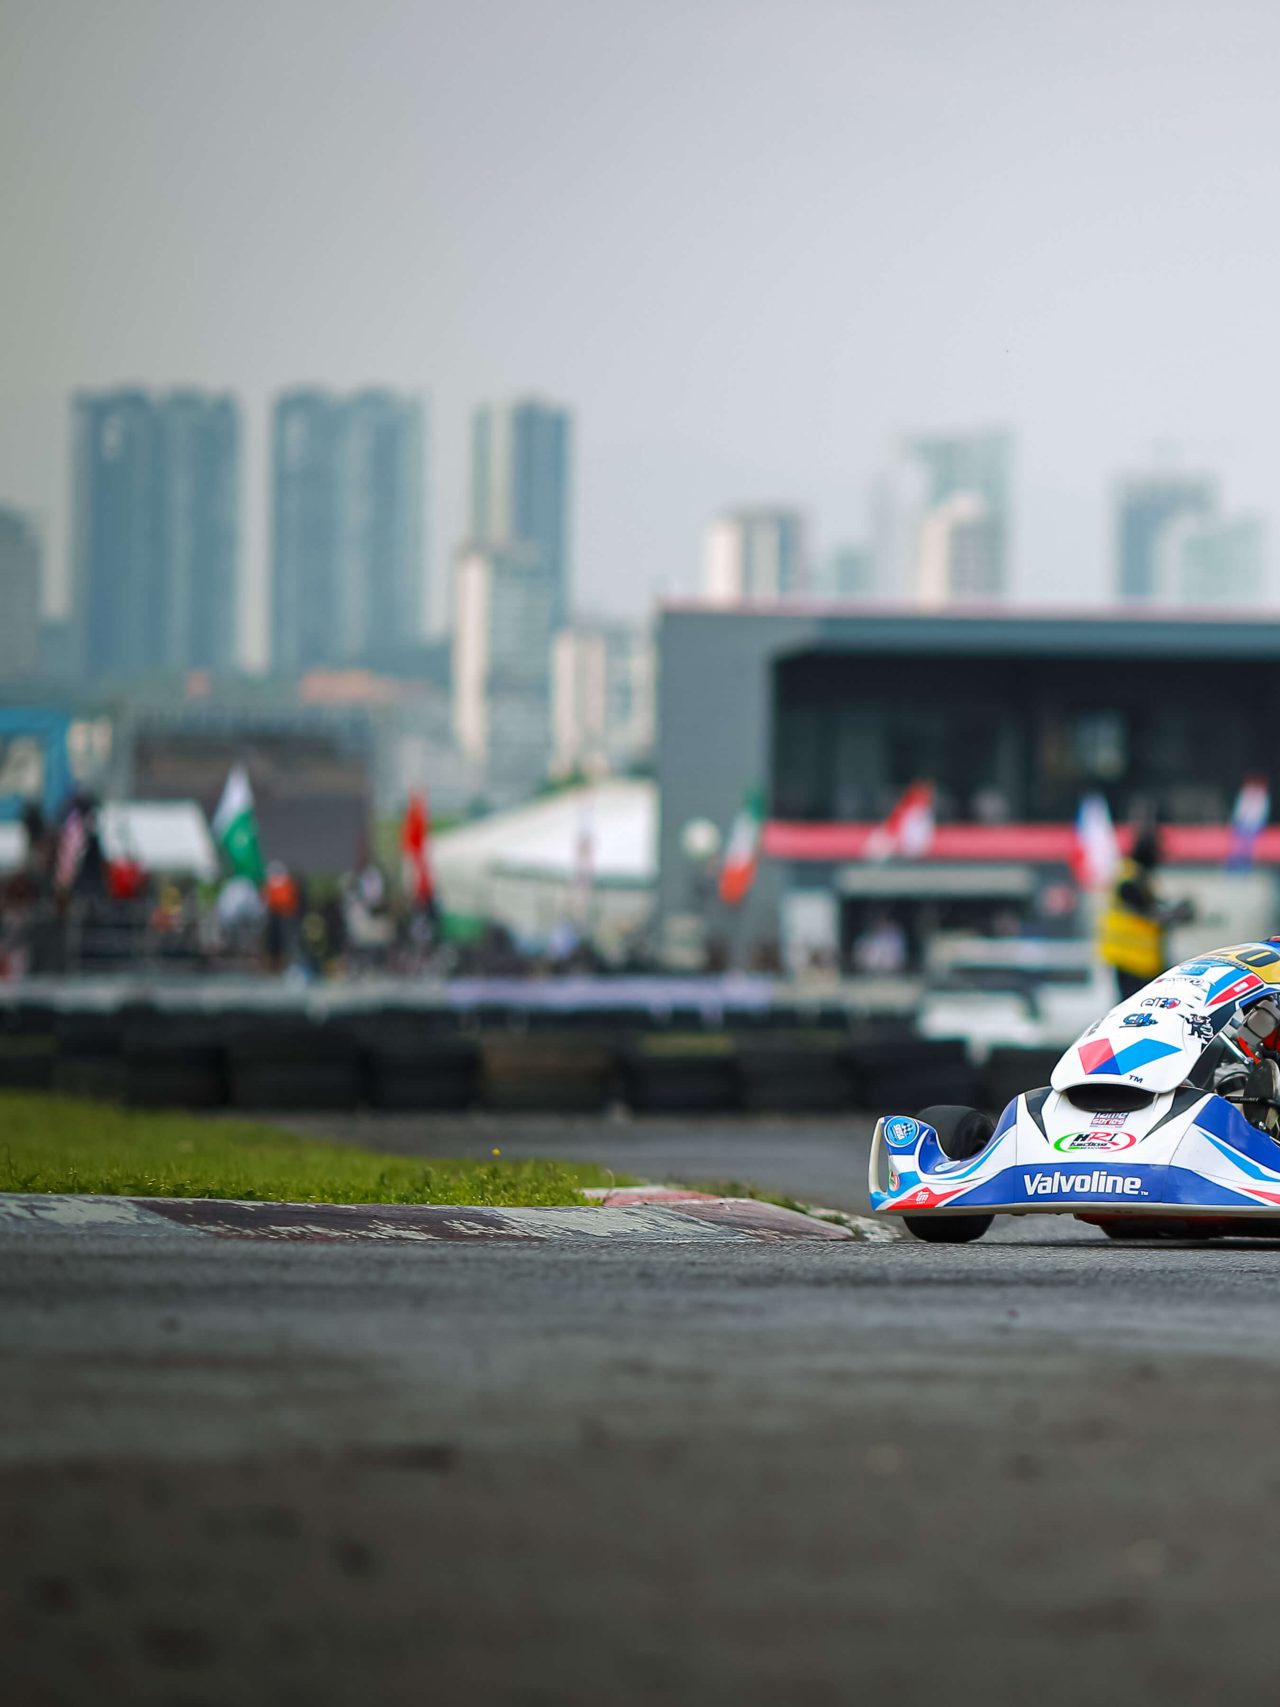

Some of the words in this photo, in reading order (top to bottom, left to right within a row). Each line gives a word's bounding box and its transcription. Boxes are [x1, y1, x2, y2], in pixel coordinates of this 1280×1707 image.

[1129, 1075, 1143, 1083] TM
[1023, 1170, 1141, 1196] Valvoline
[916, 1191, 930, 1202] tm
